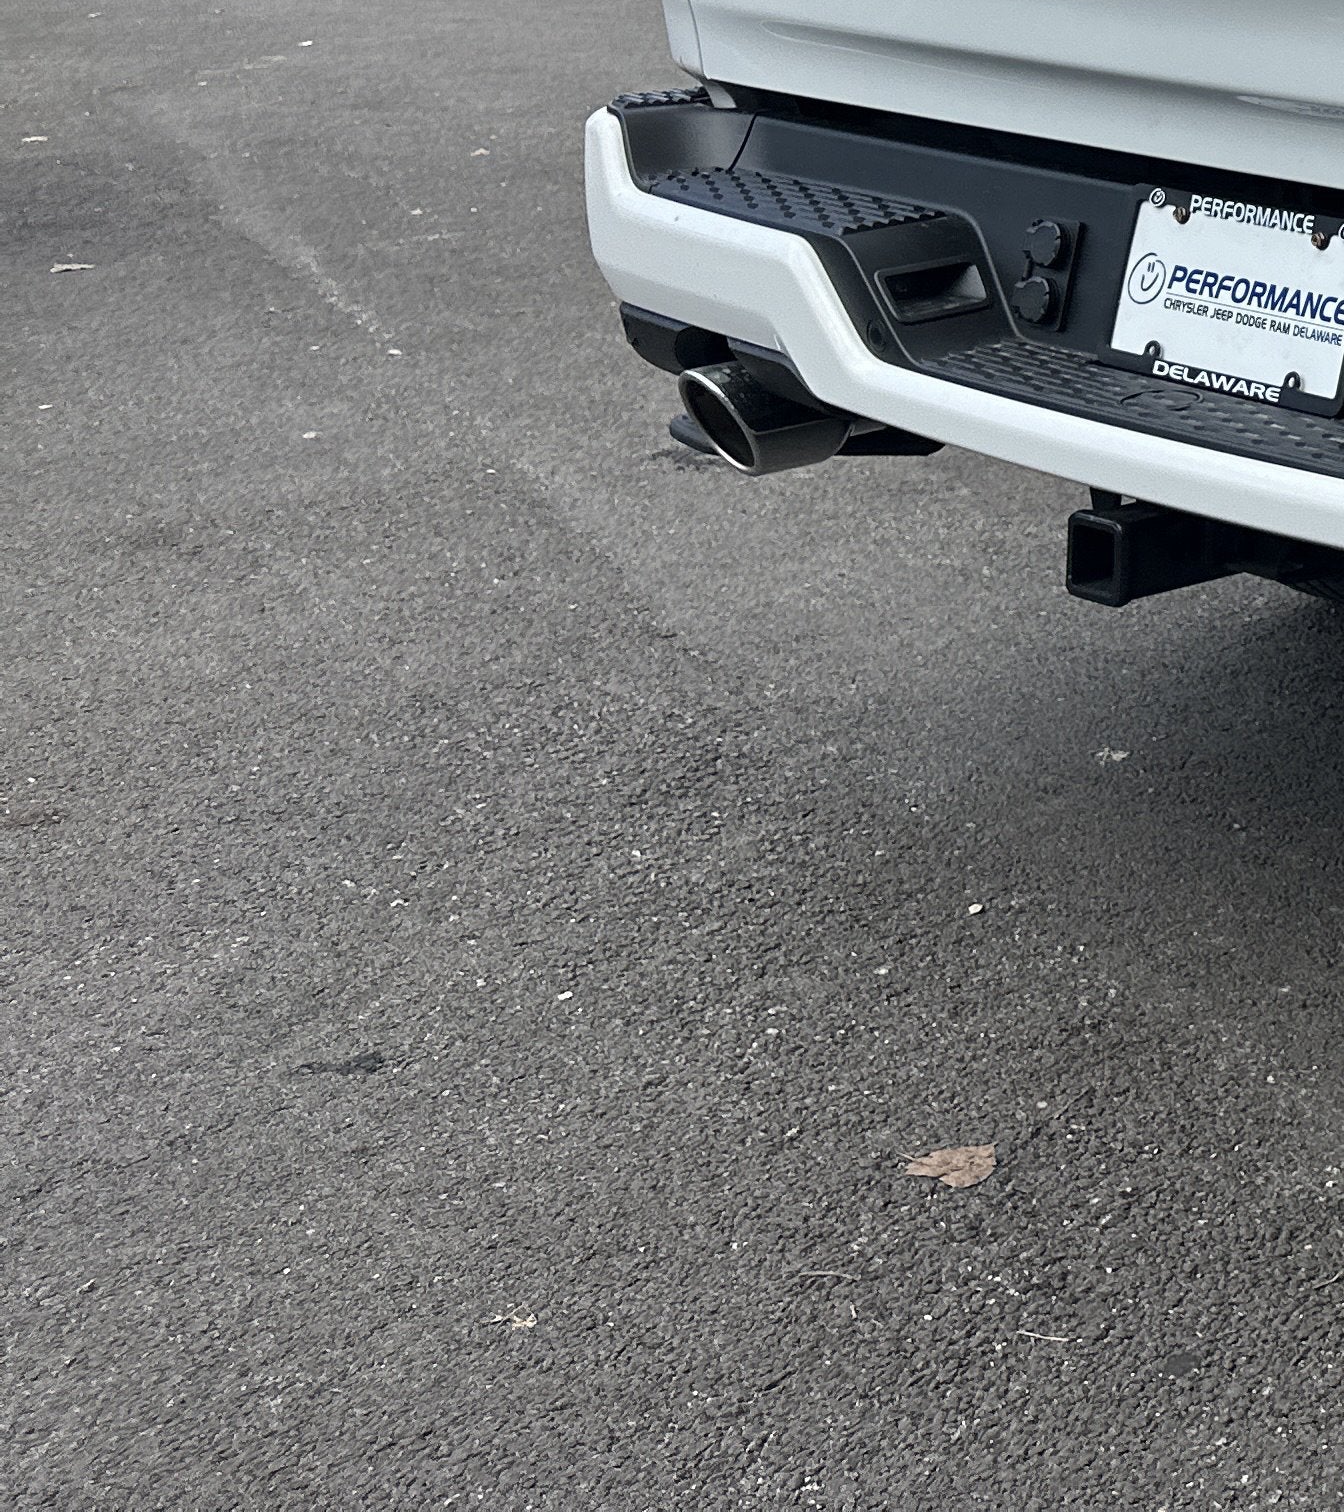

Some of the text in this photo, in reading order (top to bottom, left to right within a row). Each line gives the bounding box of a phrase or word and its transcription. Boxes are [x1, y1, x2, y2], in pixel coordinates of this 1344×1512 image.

[1190, 194, 1315, 234] PERFORMANCE
[1163, 298, 1343, 347] CHRYSLER JEEP DODGE RAM DELAWARE
[1152, 360, 1282, 403] DELAWARE
